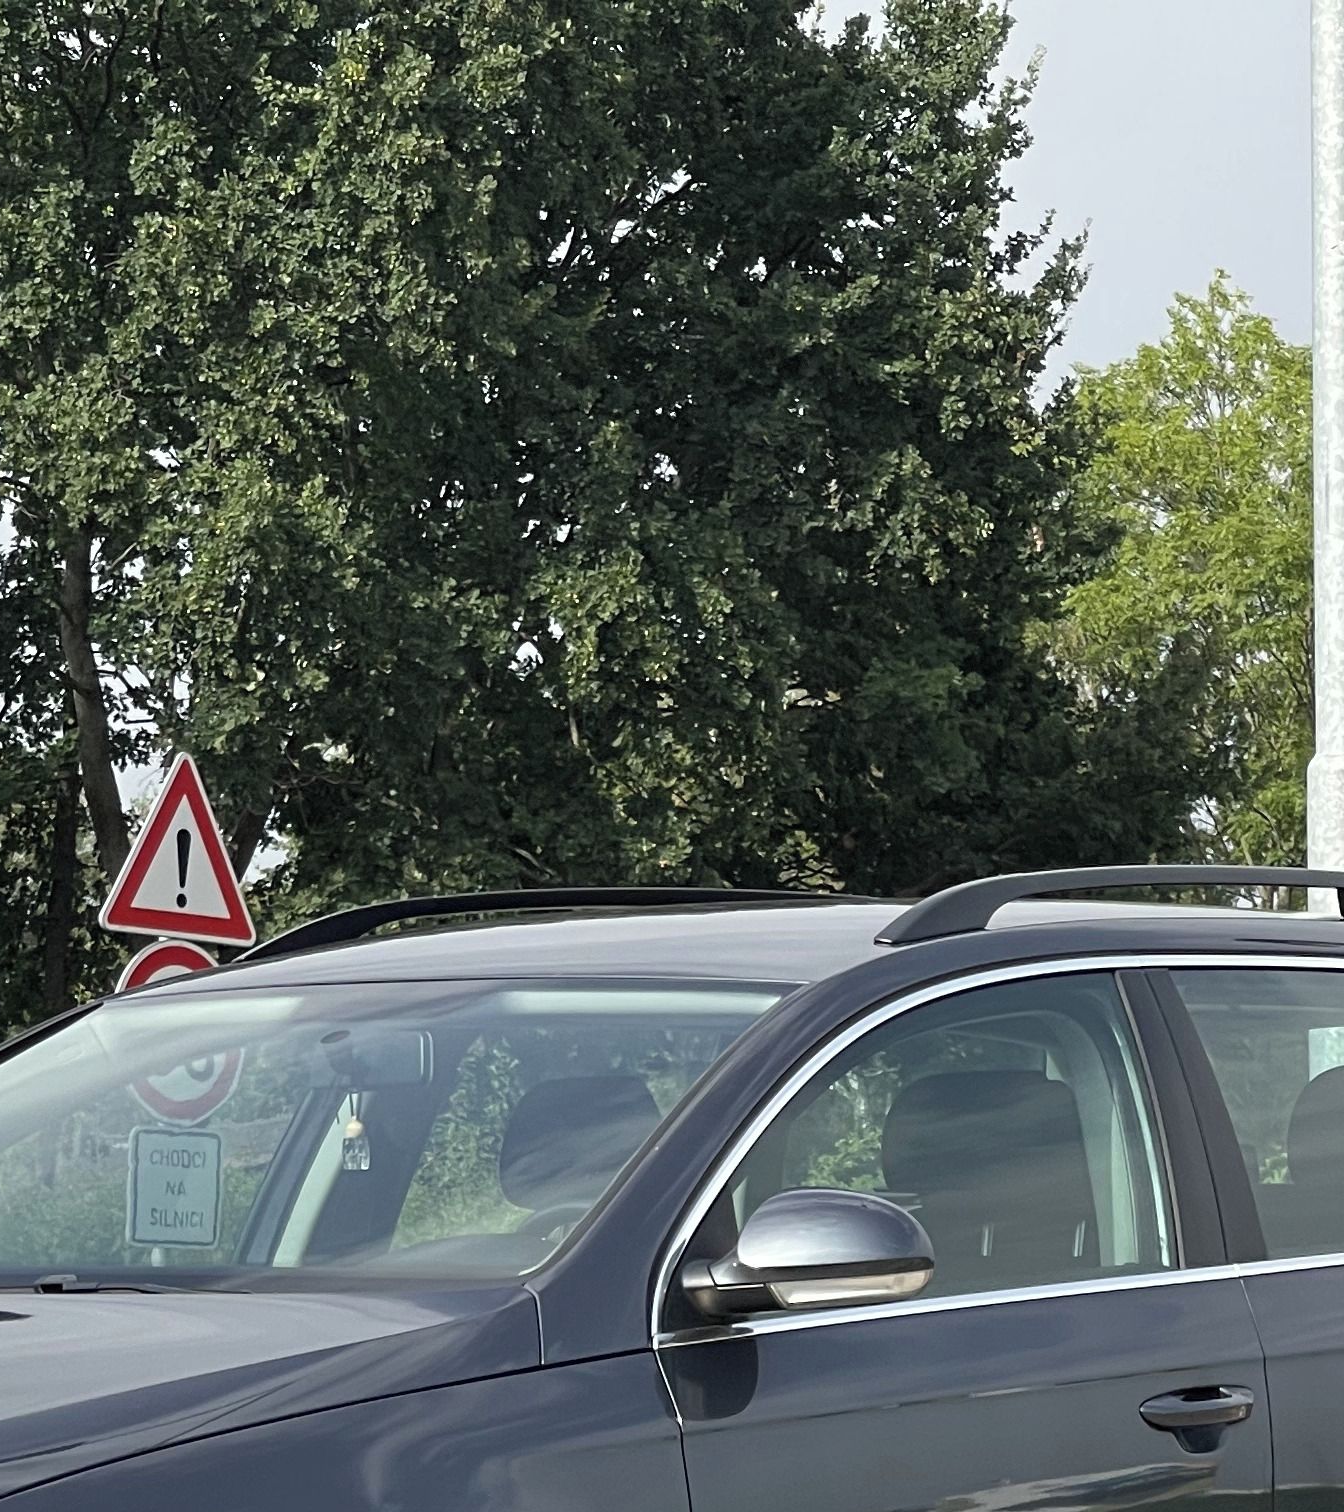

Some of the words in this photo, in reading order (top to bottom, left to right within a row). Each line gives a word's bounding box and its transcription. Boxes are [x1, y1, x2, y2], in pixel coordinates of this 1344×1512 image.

[150, 1149, 206, 1169] CHODCI
[165, 1181, 186, 1196] NA
[149, 1207, 204, 1228] SILNICI
